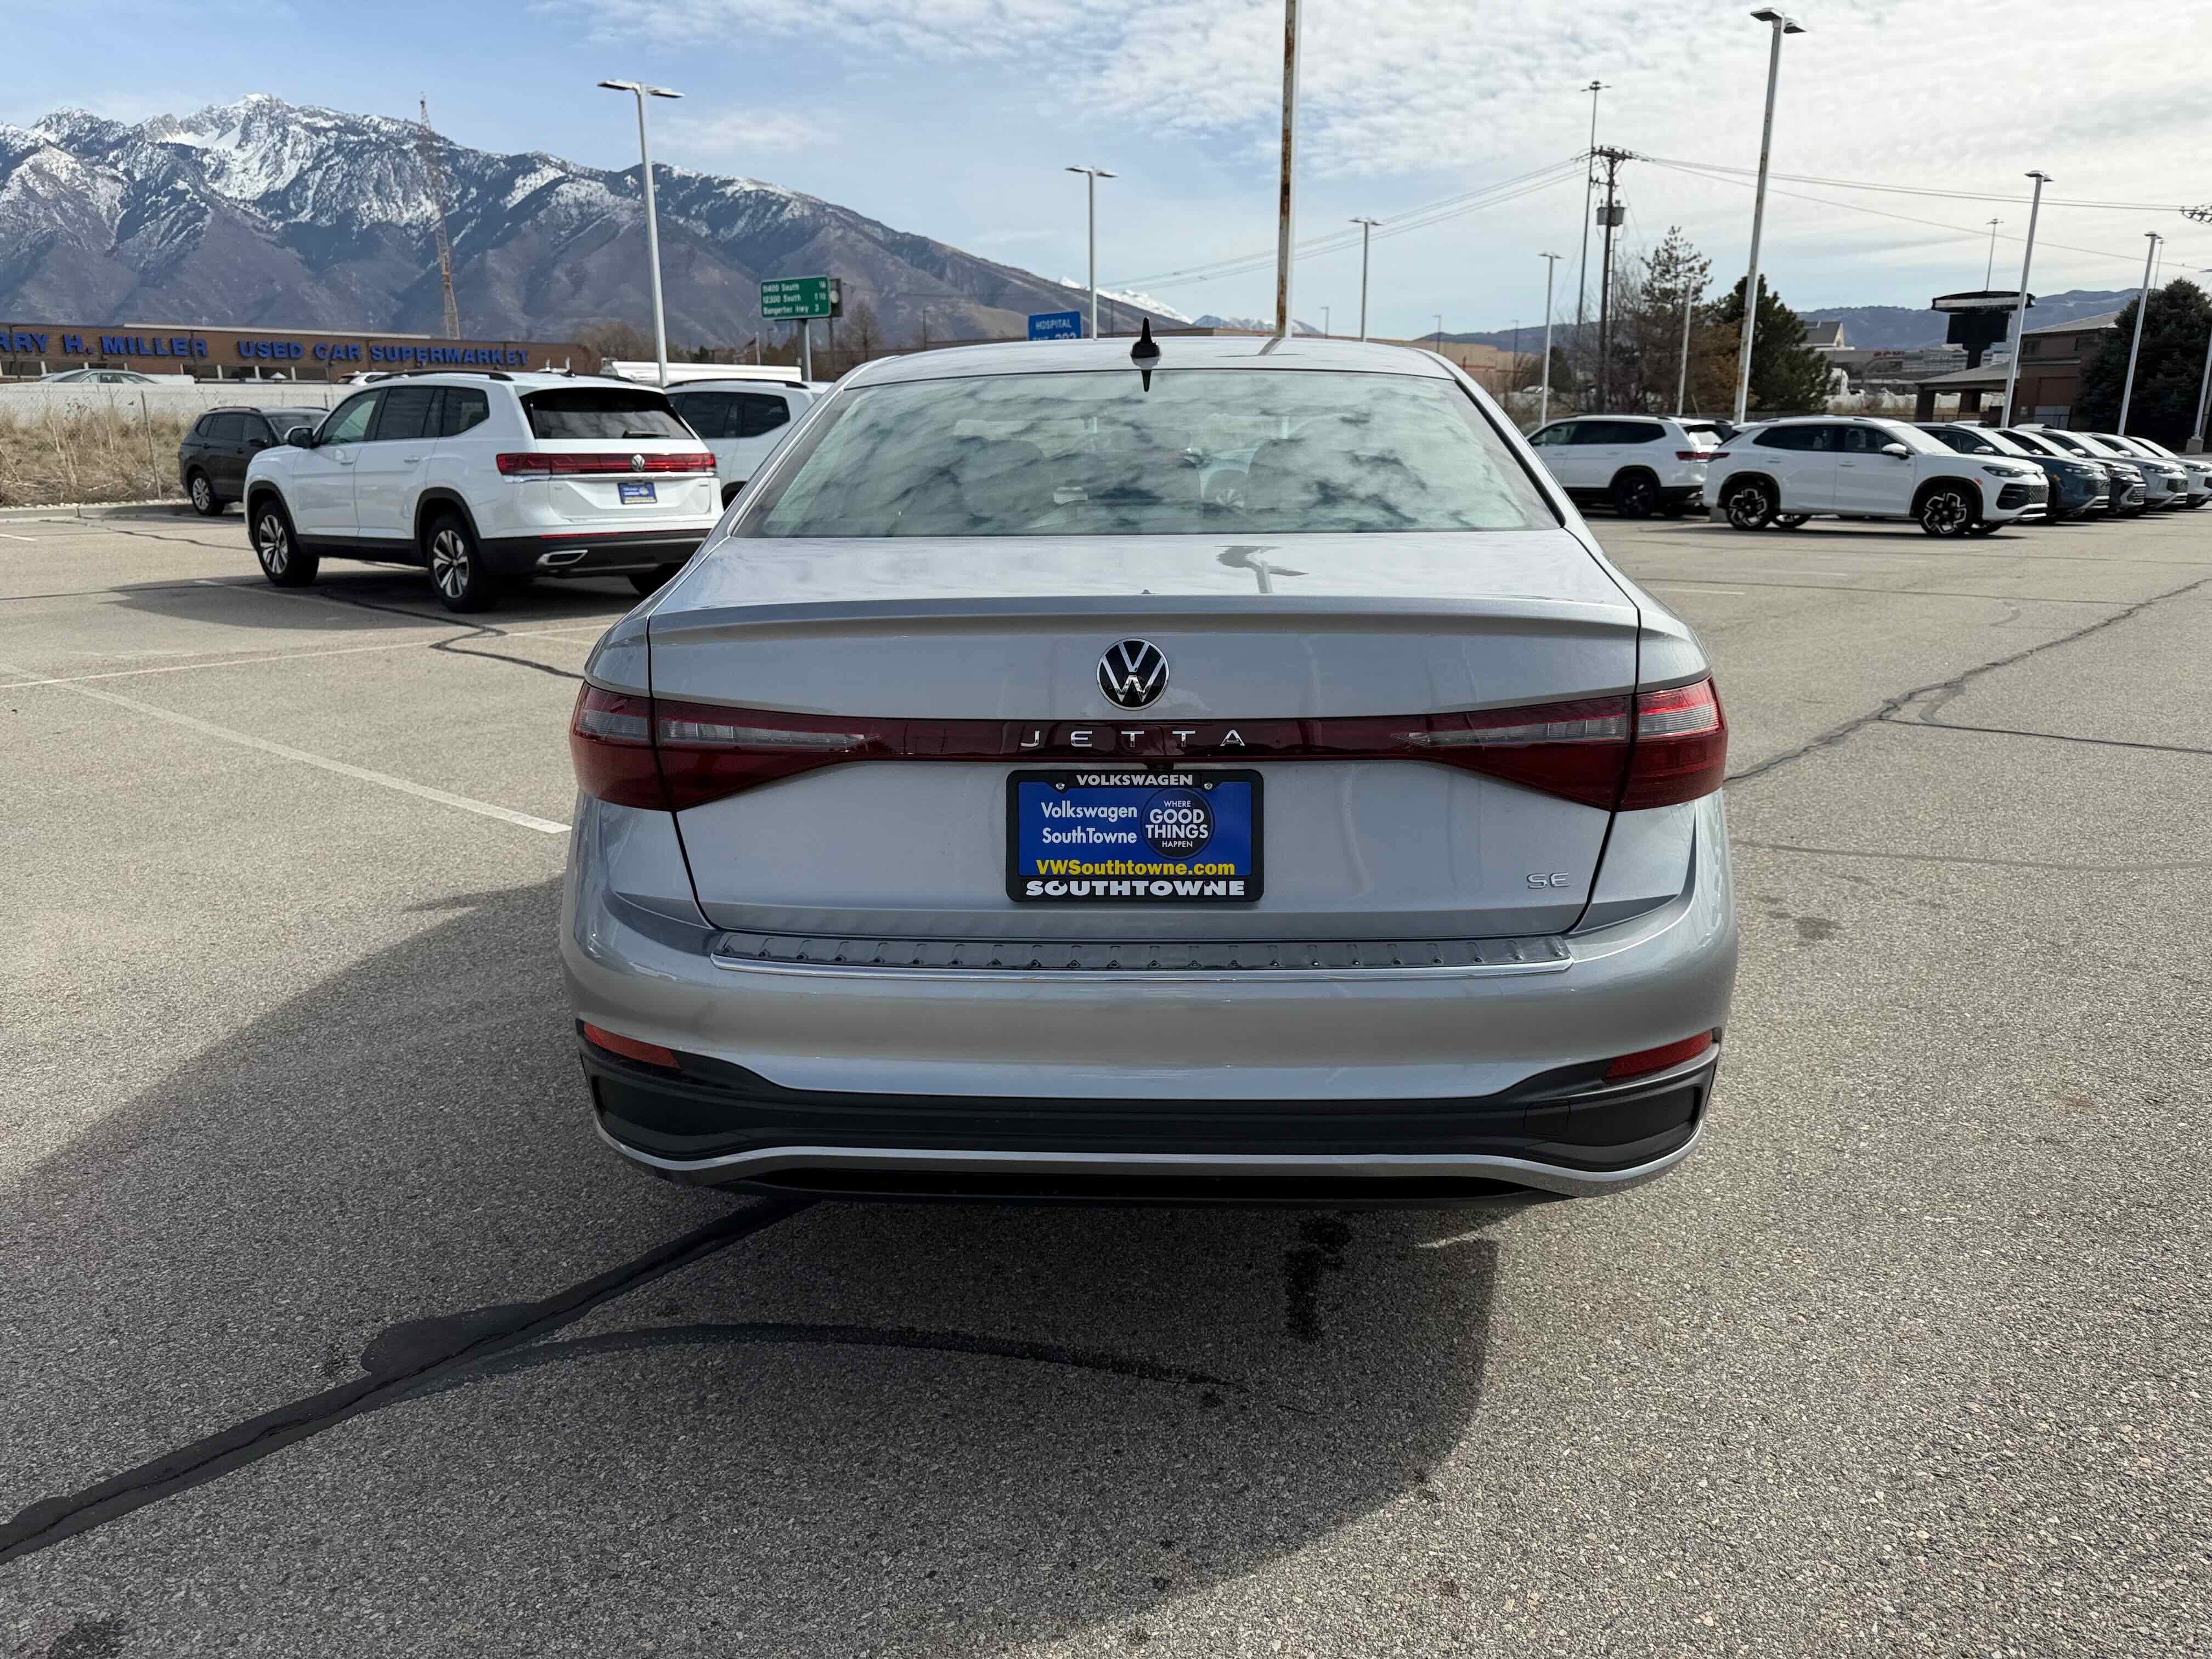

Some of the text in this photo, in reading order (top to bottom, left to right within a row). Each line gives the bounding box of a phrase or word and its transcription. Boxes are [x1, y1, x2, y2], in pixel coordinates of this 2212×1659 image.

[781, 283, 799, 292] South
[783, 294, 801, 303] South
[1036, 319, 1071, 330] HOSPITAL
[101, 336, 208, 357] MILLER
[238, 341, 527, 366] USED CAR SUPERMARKET
[1020, 729, 1245, 747] JETTA
[1076, 775, 1193, 786] VOLKSWAGEN
[1041, 800, 1137, 822] Volkswagen
[1149, 809, 1205, 824] GOOD
[1042, 826, 1137, 844] SouthTowne
[1145, 824, 1209, 839] THINGS
[1036, 860, 1235, 876] VWSouthtowne.com
[1527, 872, 1571, 889] SE
[1025, 881, 1245, 896] SOUTHTOWNE
